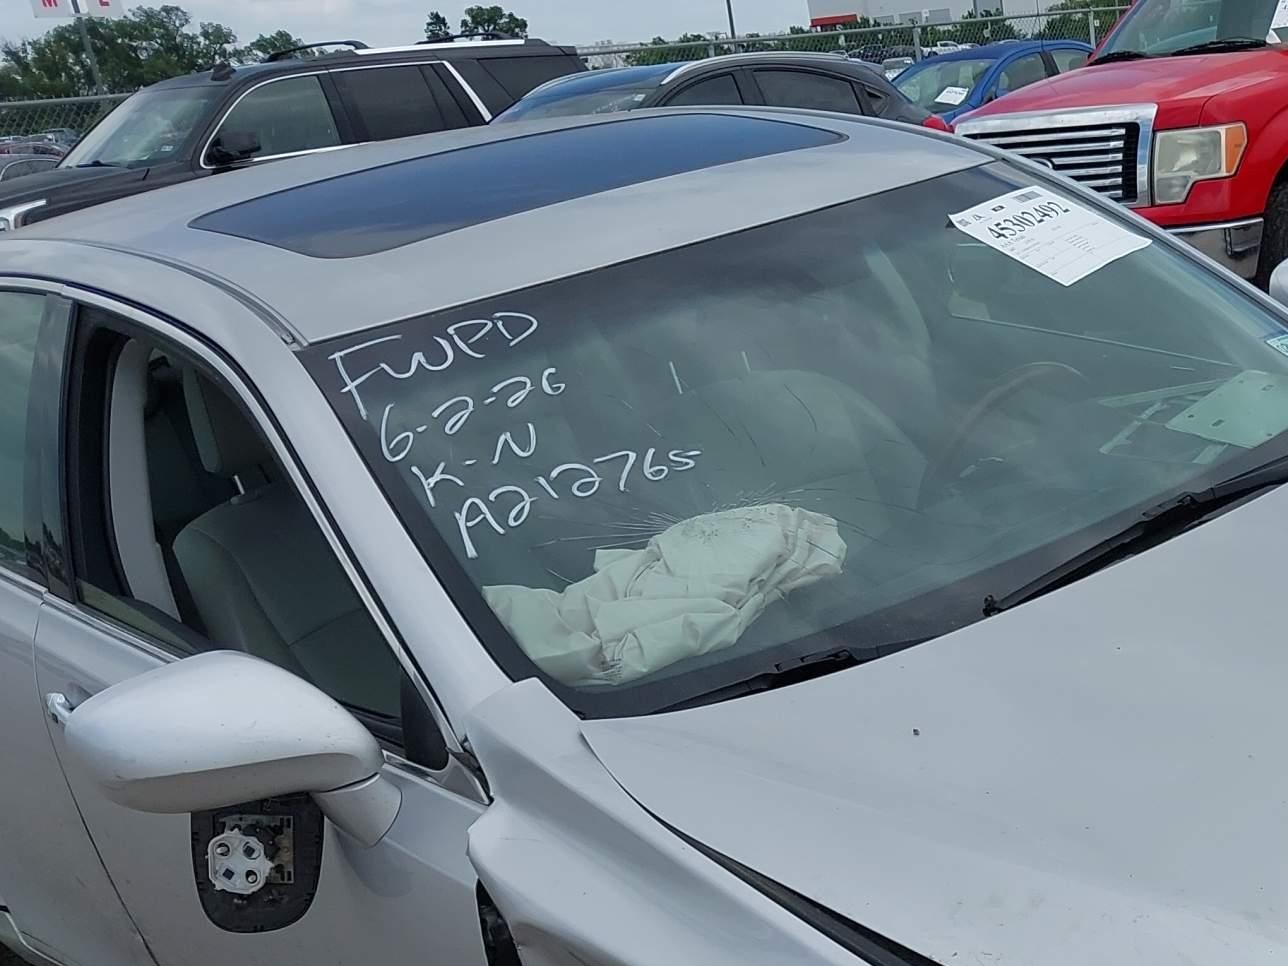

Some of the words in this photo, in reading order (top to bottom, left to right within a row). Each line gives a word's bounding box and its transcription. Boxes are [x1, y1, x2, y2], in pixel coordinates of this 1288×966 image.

[987, 201, 1070, 239] 45302492
[328, 312, 538, 420] FWPD
[379, 367, 567, 463] 6-2-26
[453, 447, 703, 559] A212765
